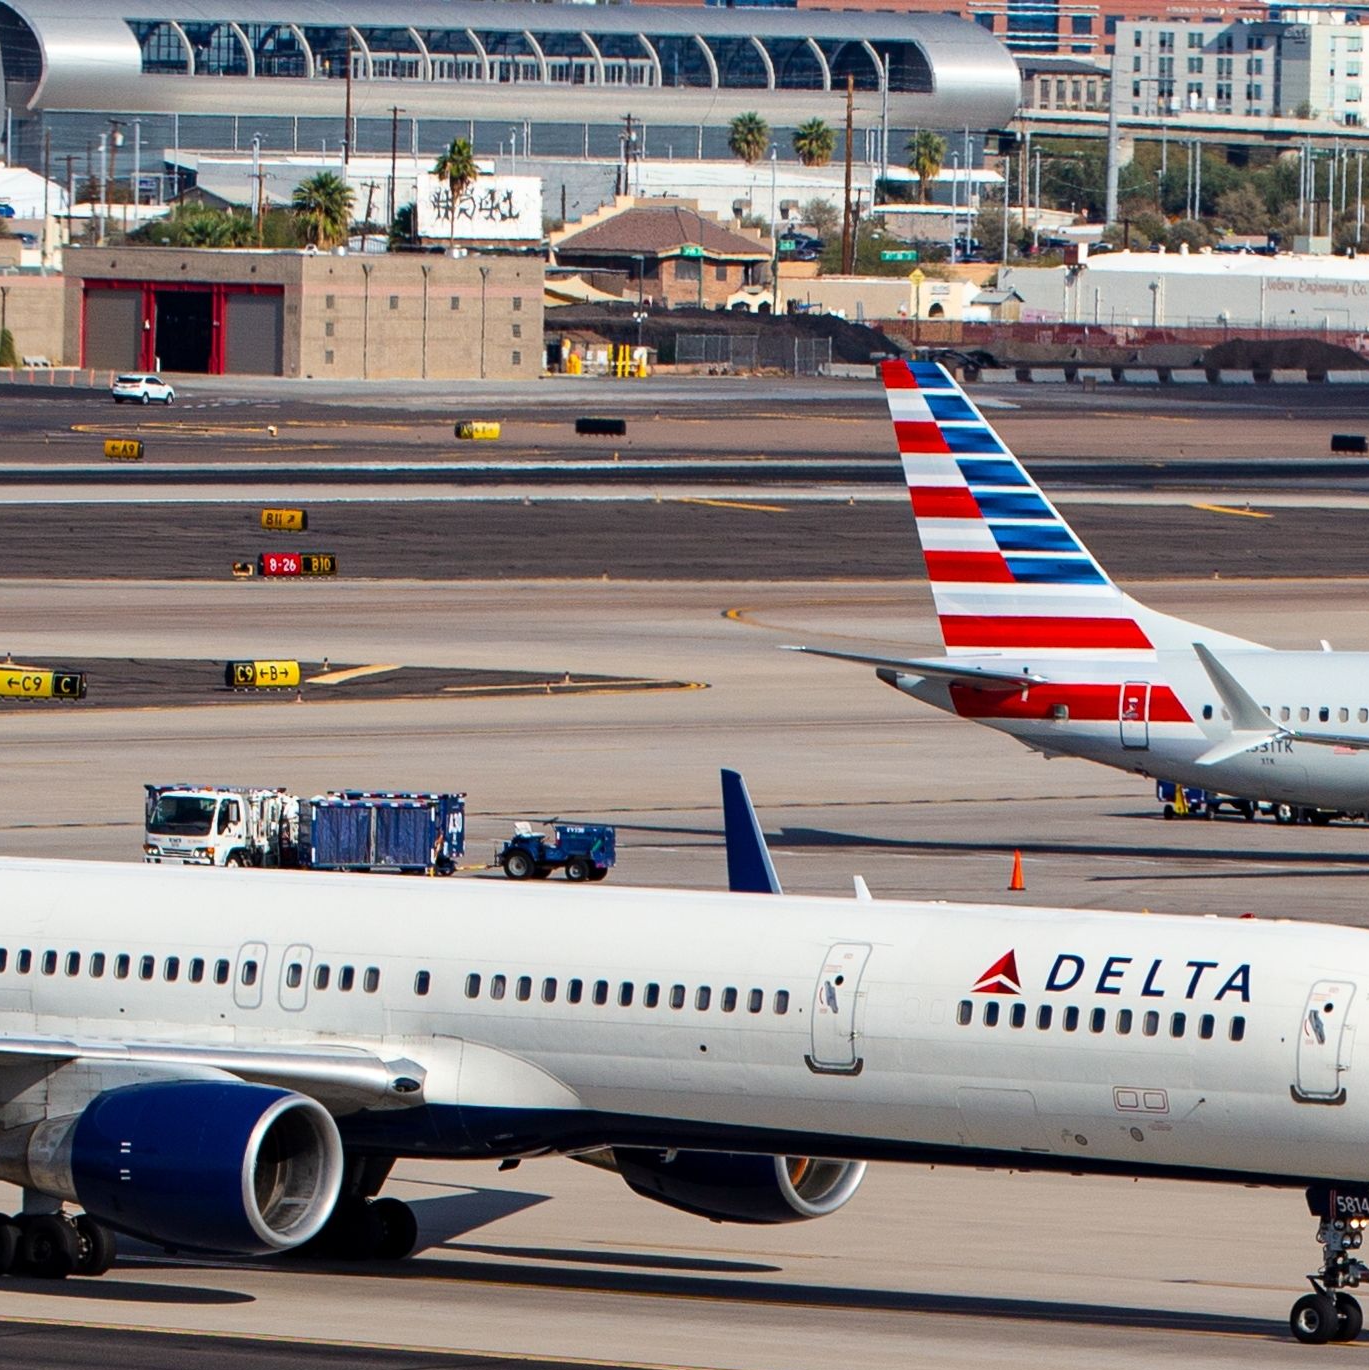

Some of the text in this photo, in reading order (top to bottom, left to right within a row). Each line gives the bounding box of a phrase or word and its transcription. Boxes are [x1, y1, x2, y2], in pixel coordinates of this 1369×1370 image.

[121, 444, 135, 456] A9
[266, 513, 283, 526] B11
[269, 558, 332, 572] 8-26 B10
[236, 664, 278, 681] C9 B
[22, 677, 71, 692] C9 C
[1246, 740, 1294, 753] 31TK
[1045, 953, 1252, 1003] DELTA
